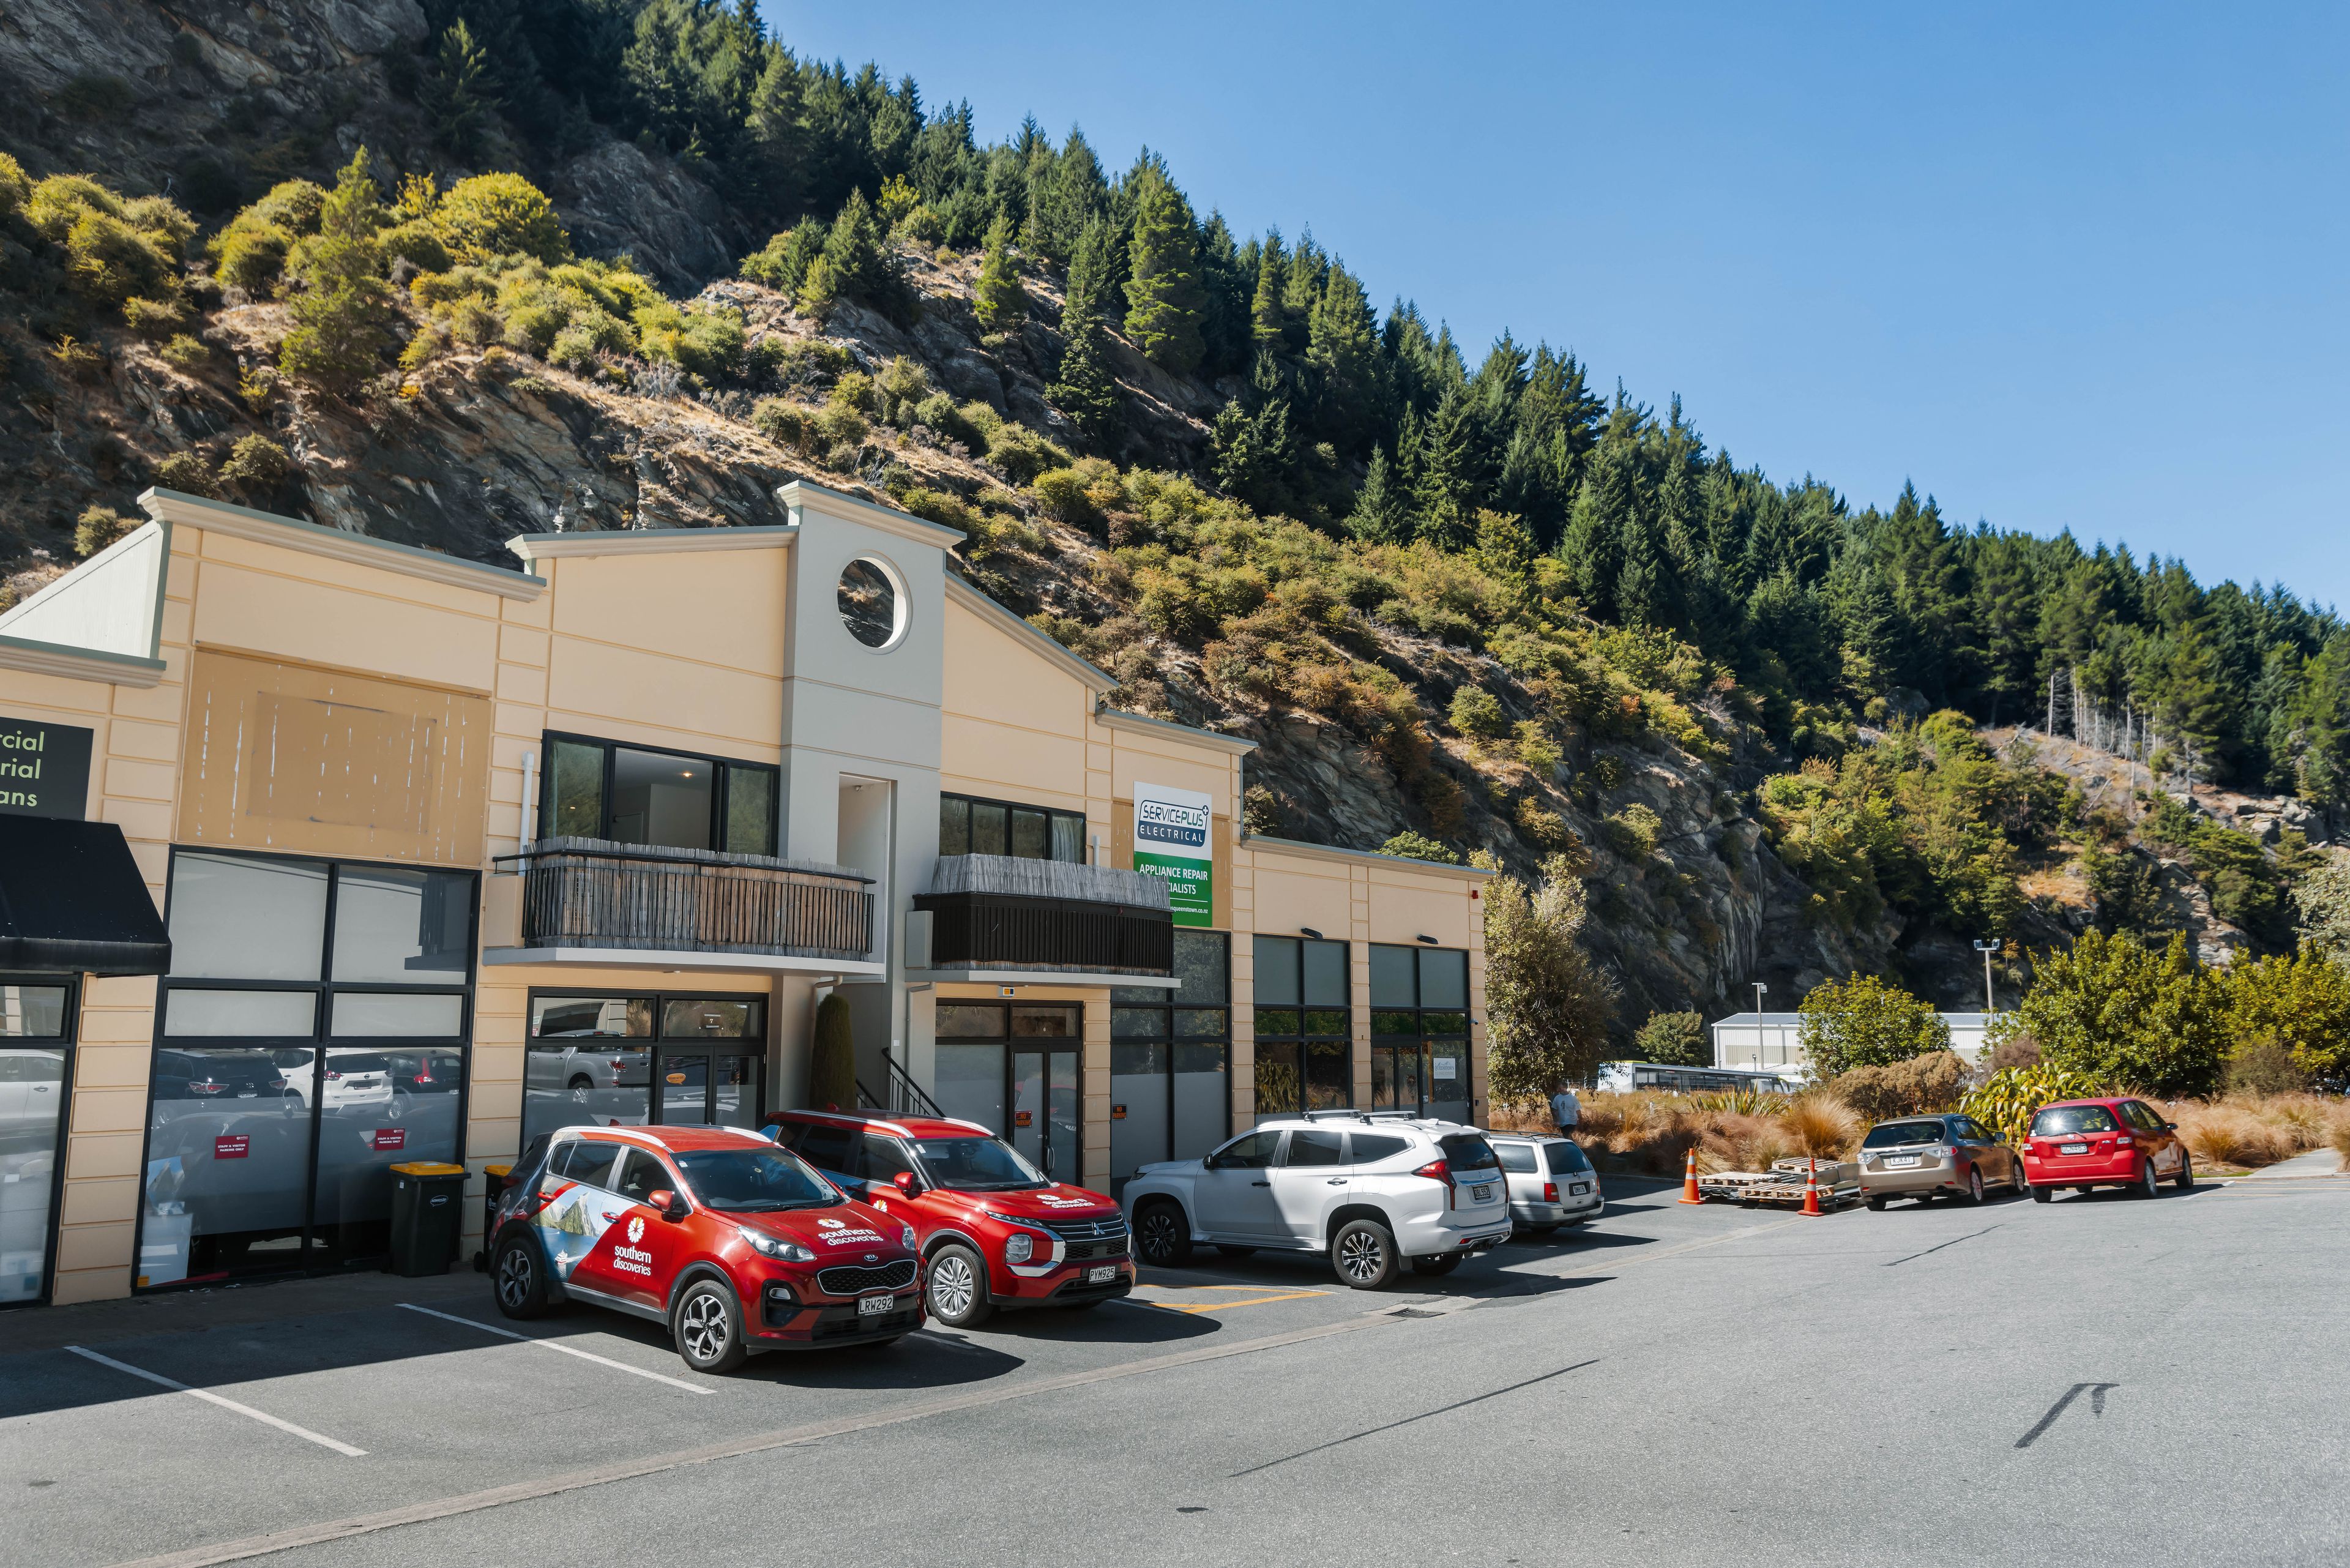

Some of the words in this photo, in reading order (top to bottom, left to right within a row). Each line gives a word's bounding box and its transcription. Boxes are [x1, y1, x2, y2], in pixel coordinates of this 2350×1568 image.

[0, 730, 45, 752] cial
[1143, 805, 1203, 827] SERVICEPLUS
[1140, 825, 1203, 842] ELECTRICAL
[1140, 864, 1181, 878] APPLIANCE
[1183, 868, 1208, 881] REPAIR
[1168, 882, 1196, 894] IALISTS
[818, 1228, 876, 1239] southern
[827, 1234, 884, 1245] discoveries
[614, 1245, 651, 1264] southern
[613, 1256, 651, 1276] discoveries
[1089, 1267, 1114, 1280] PYM925
[859, 1297, 892, 1313] LRW292
